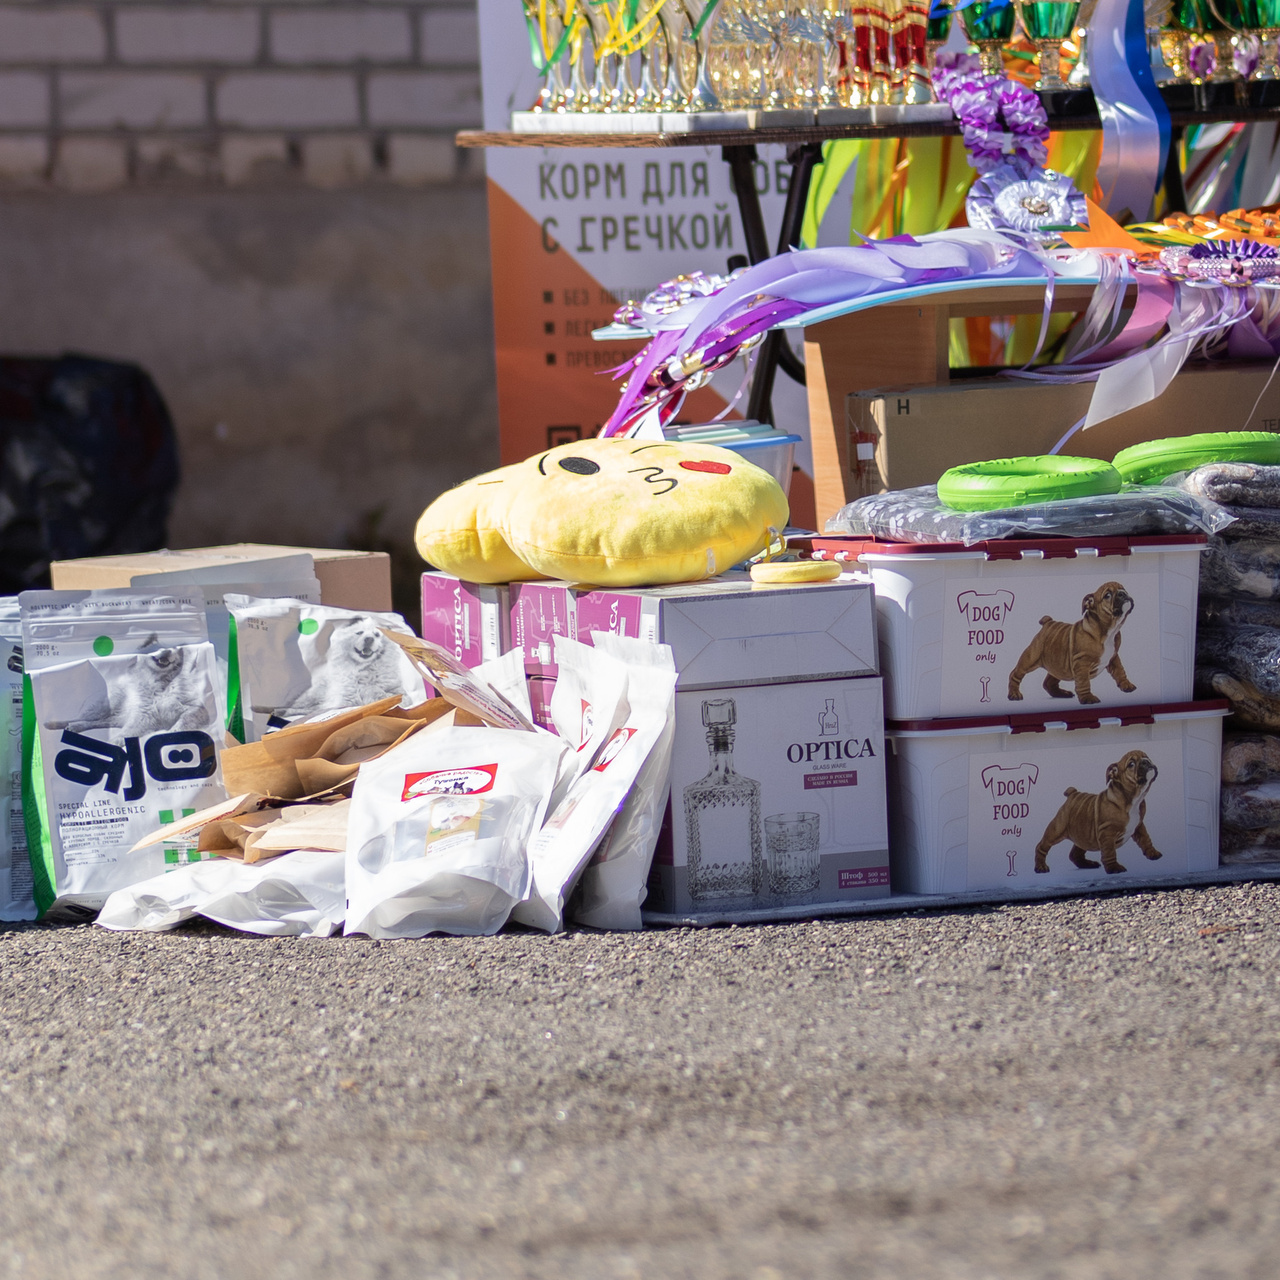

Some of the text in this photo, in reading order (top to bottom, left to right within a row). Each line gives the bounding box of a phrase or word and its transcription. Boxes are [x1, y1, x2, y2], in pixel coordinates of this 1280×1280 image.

[539, 162, 627, 200] КОРМ
[642, 161, 710, 205] ДЛЯ
[541, 203, 733, 253] С ГРЕЧКОЙ
[563, 288, 589, 306] БЕЗ
[972, 605, 1001, 622] DOG
[453, 586, 463, 662] OPTICA
[967, 629, 1004, 646] FOOD
[975, 650, 996, 664] only
[786, 738, 877, 763] OPTICA
[996, 779, 1026, 797] DOG
[58, 799, 112, 810] SPECIAL LINE
[60, 806, 146, 820] HYPOALLERGENIC
[992, 802, 1030, 820] FOOD
[1001, 824, 1022, 838] only
[841, 871, 864, 880] Штоф
